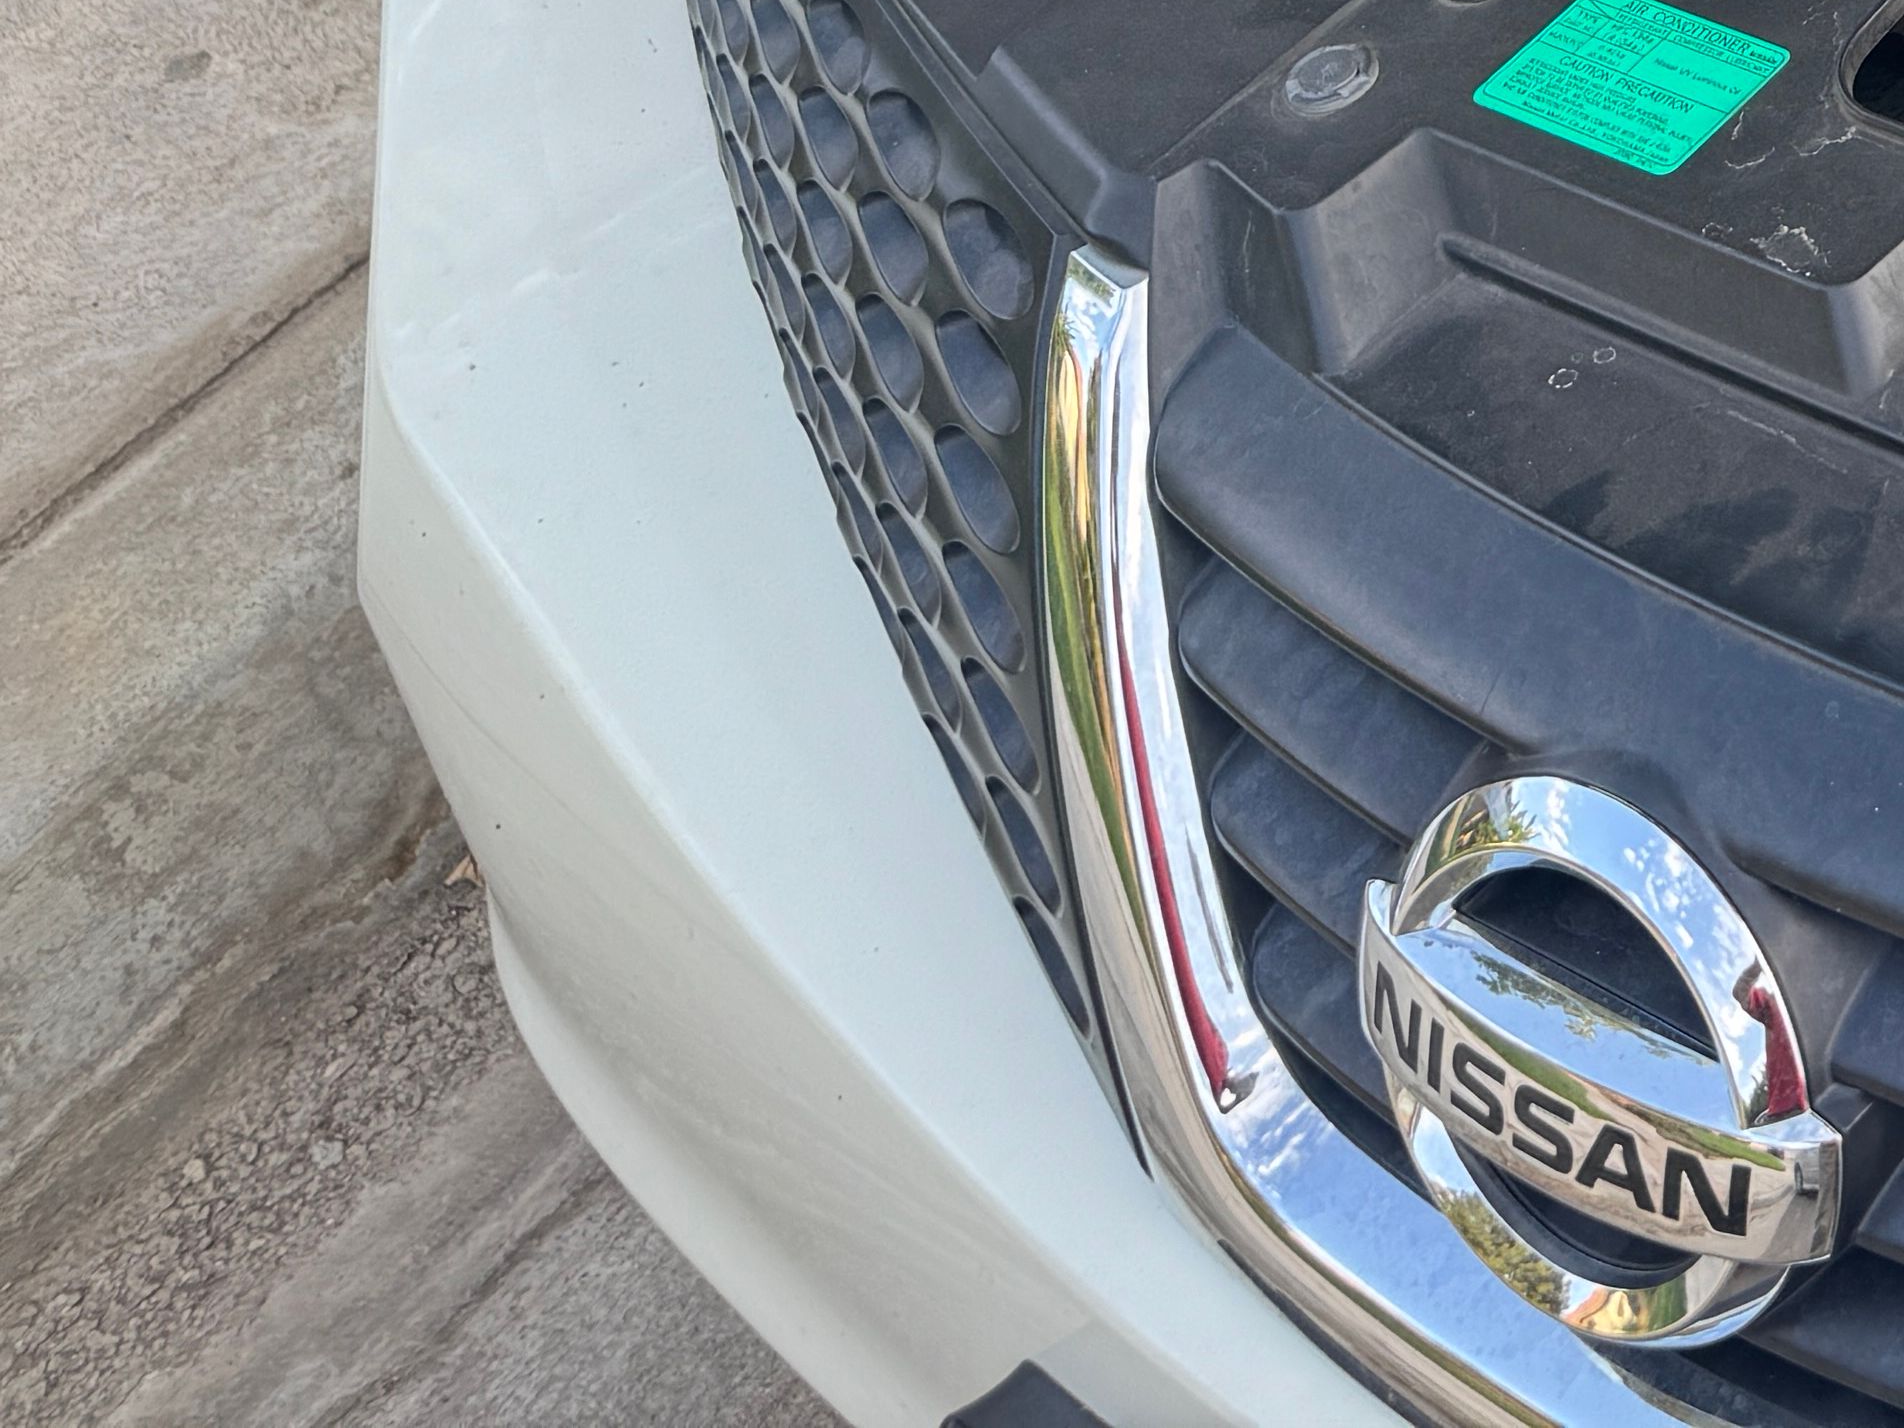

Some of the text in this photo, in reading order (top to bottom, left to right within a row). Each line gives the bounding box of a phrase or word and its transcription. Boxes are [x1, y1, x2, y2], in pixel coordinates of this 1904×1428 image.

[1625, 0, 1751, 54] AIR CONDITIONER
[1559, 56, 1613, 81] CAUTION
[1373, 961, 1753, 1237] NISSAN
